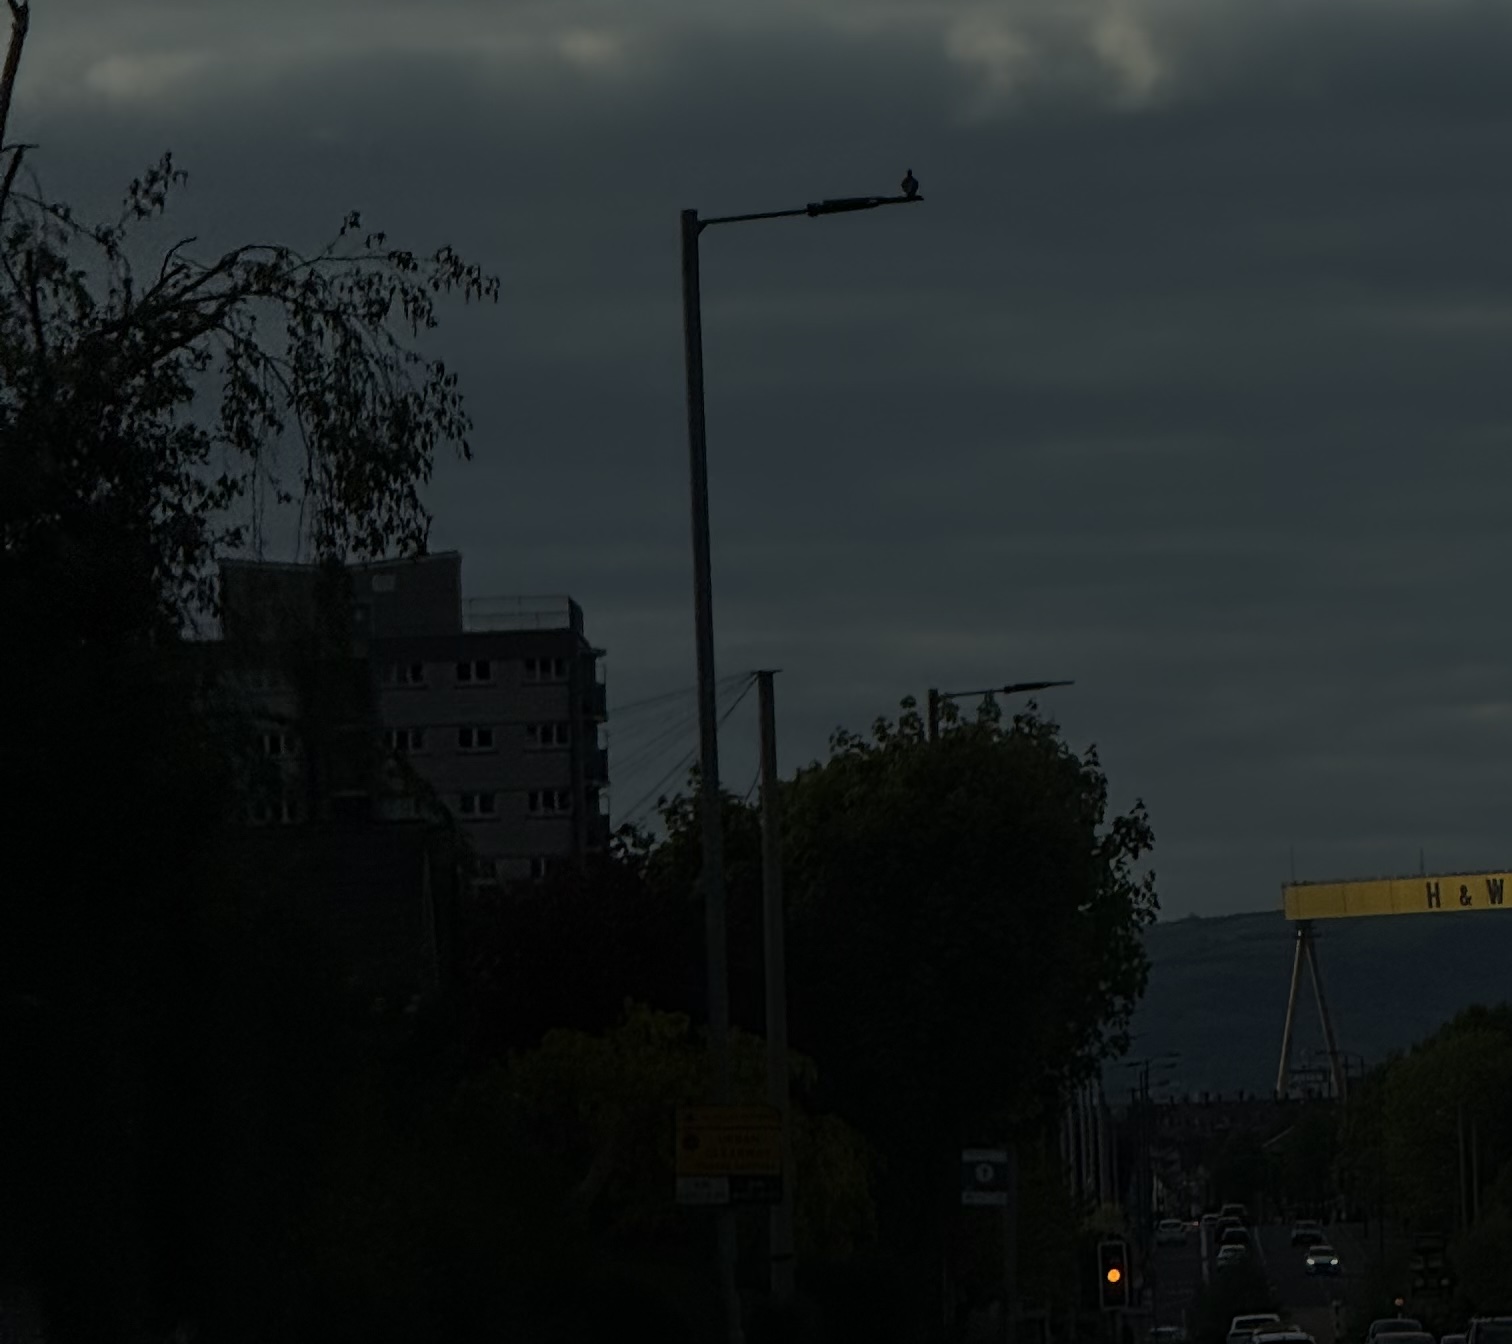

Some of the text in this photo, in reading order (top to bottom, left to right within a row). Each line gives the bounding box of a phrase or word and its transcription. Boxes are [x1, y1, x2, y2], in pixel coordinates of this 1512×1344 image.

[1426, 878, 1504, 909] H & W
